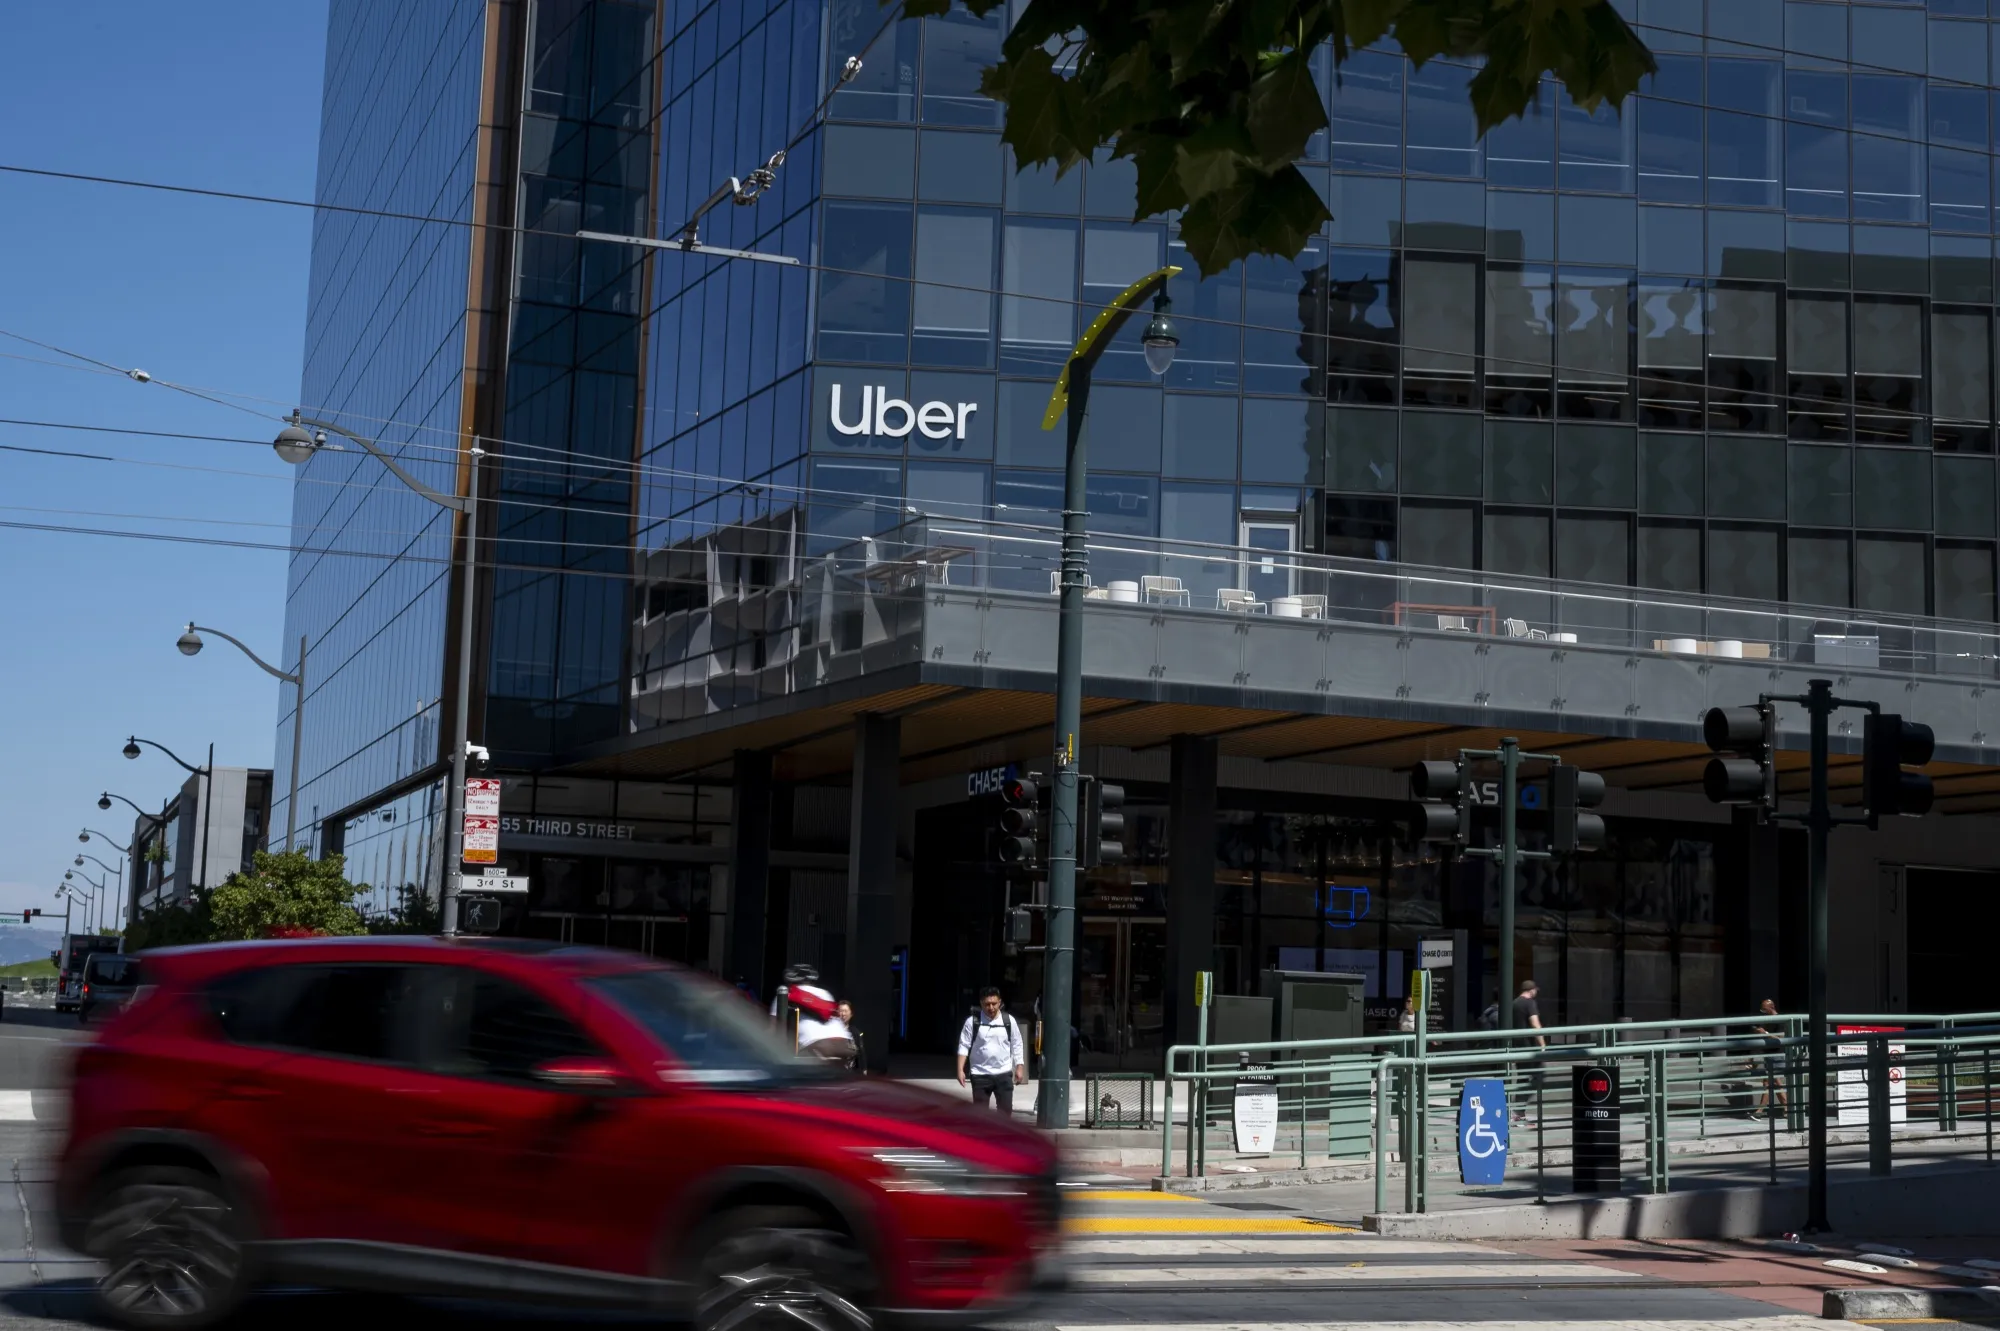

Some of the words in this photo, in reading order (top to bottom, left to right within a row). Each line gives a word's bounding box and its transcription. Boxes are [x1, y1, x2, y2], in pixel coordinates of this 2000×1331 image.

[830, 383, 978, 440] Uber
[967, 766, 1006, 796] CHASE
[467, 788, 477, 796] NO
[499, 817, 521, 832] 55
[526, 819, 571, 835] THIRD
[576, 822, 636, 840] STREET
[476, 878, 494, 888] 3rd
[502, 879, 515, 888] St
[1584, 1109, 1609, 1118] metro
